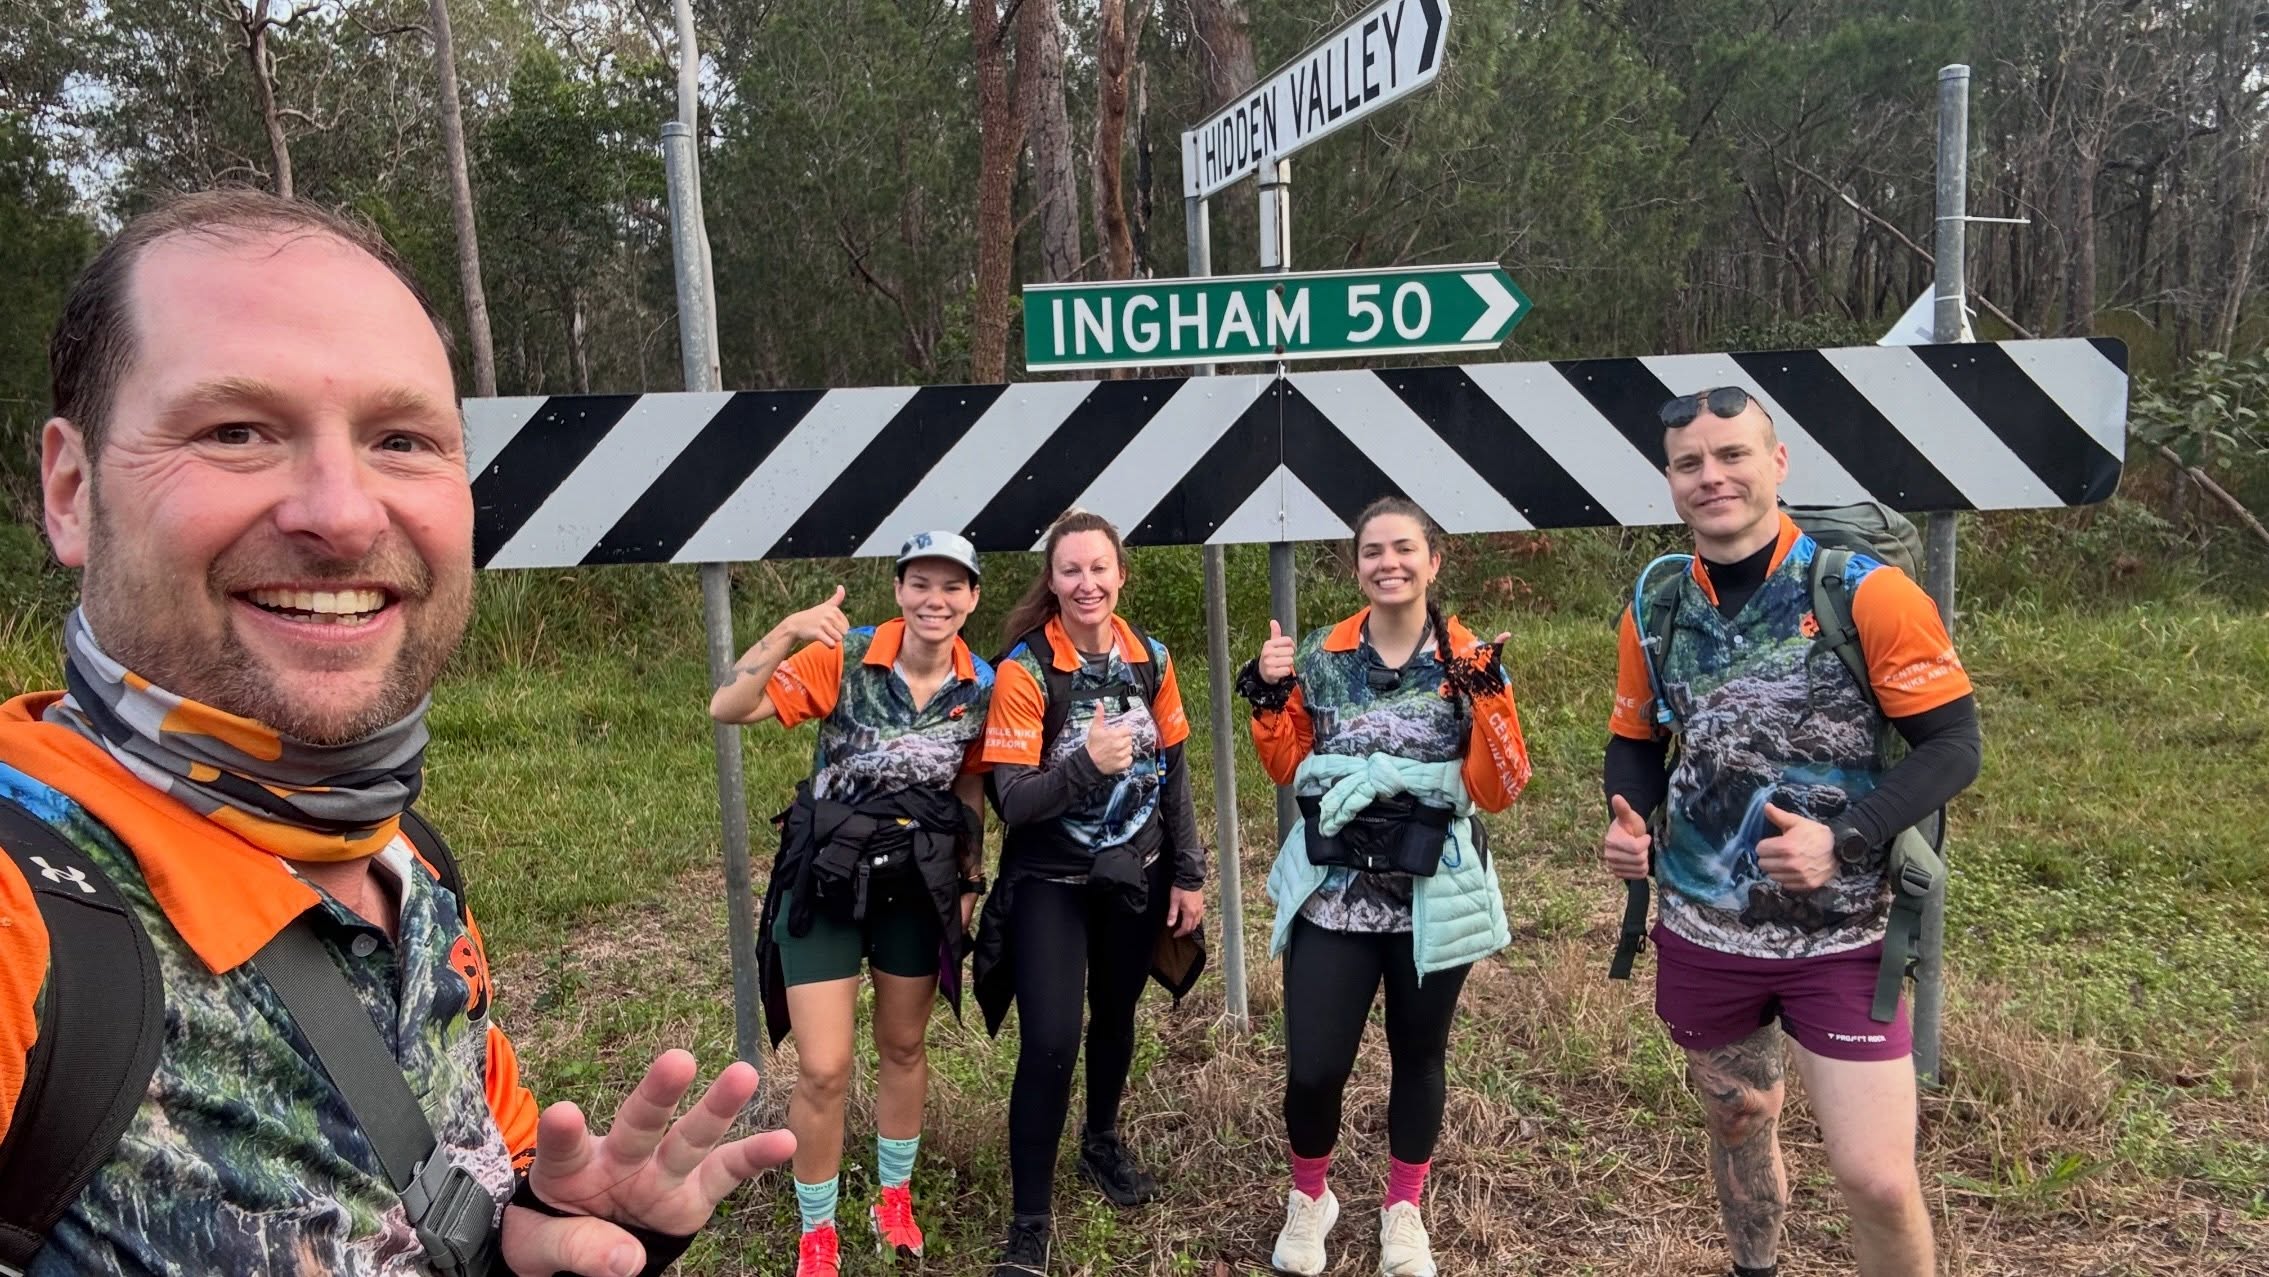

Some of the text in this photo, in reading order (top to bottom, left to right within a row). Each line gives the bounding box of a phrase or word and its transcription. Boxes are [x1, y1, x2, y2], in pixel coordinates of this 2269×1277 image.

[1204, 1, 1405, 187] HIDDEN VALLEY
[1052, 281, 1432, 356] INGHAM 50
[984, 738, 1028, 752] EXPLORE
